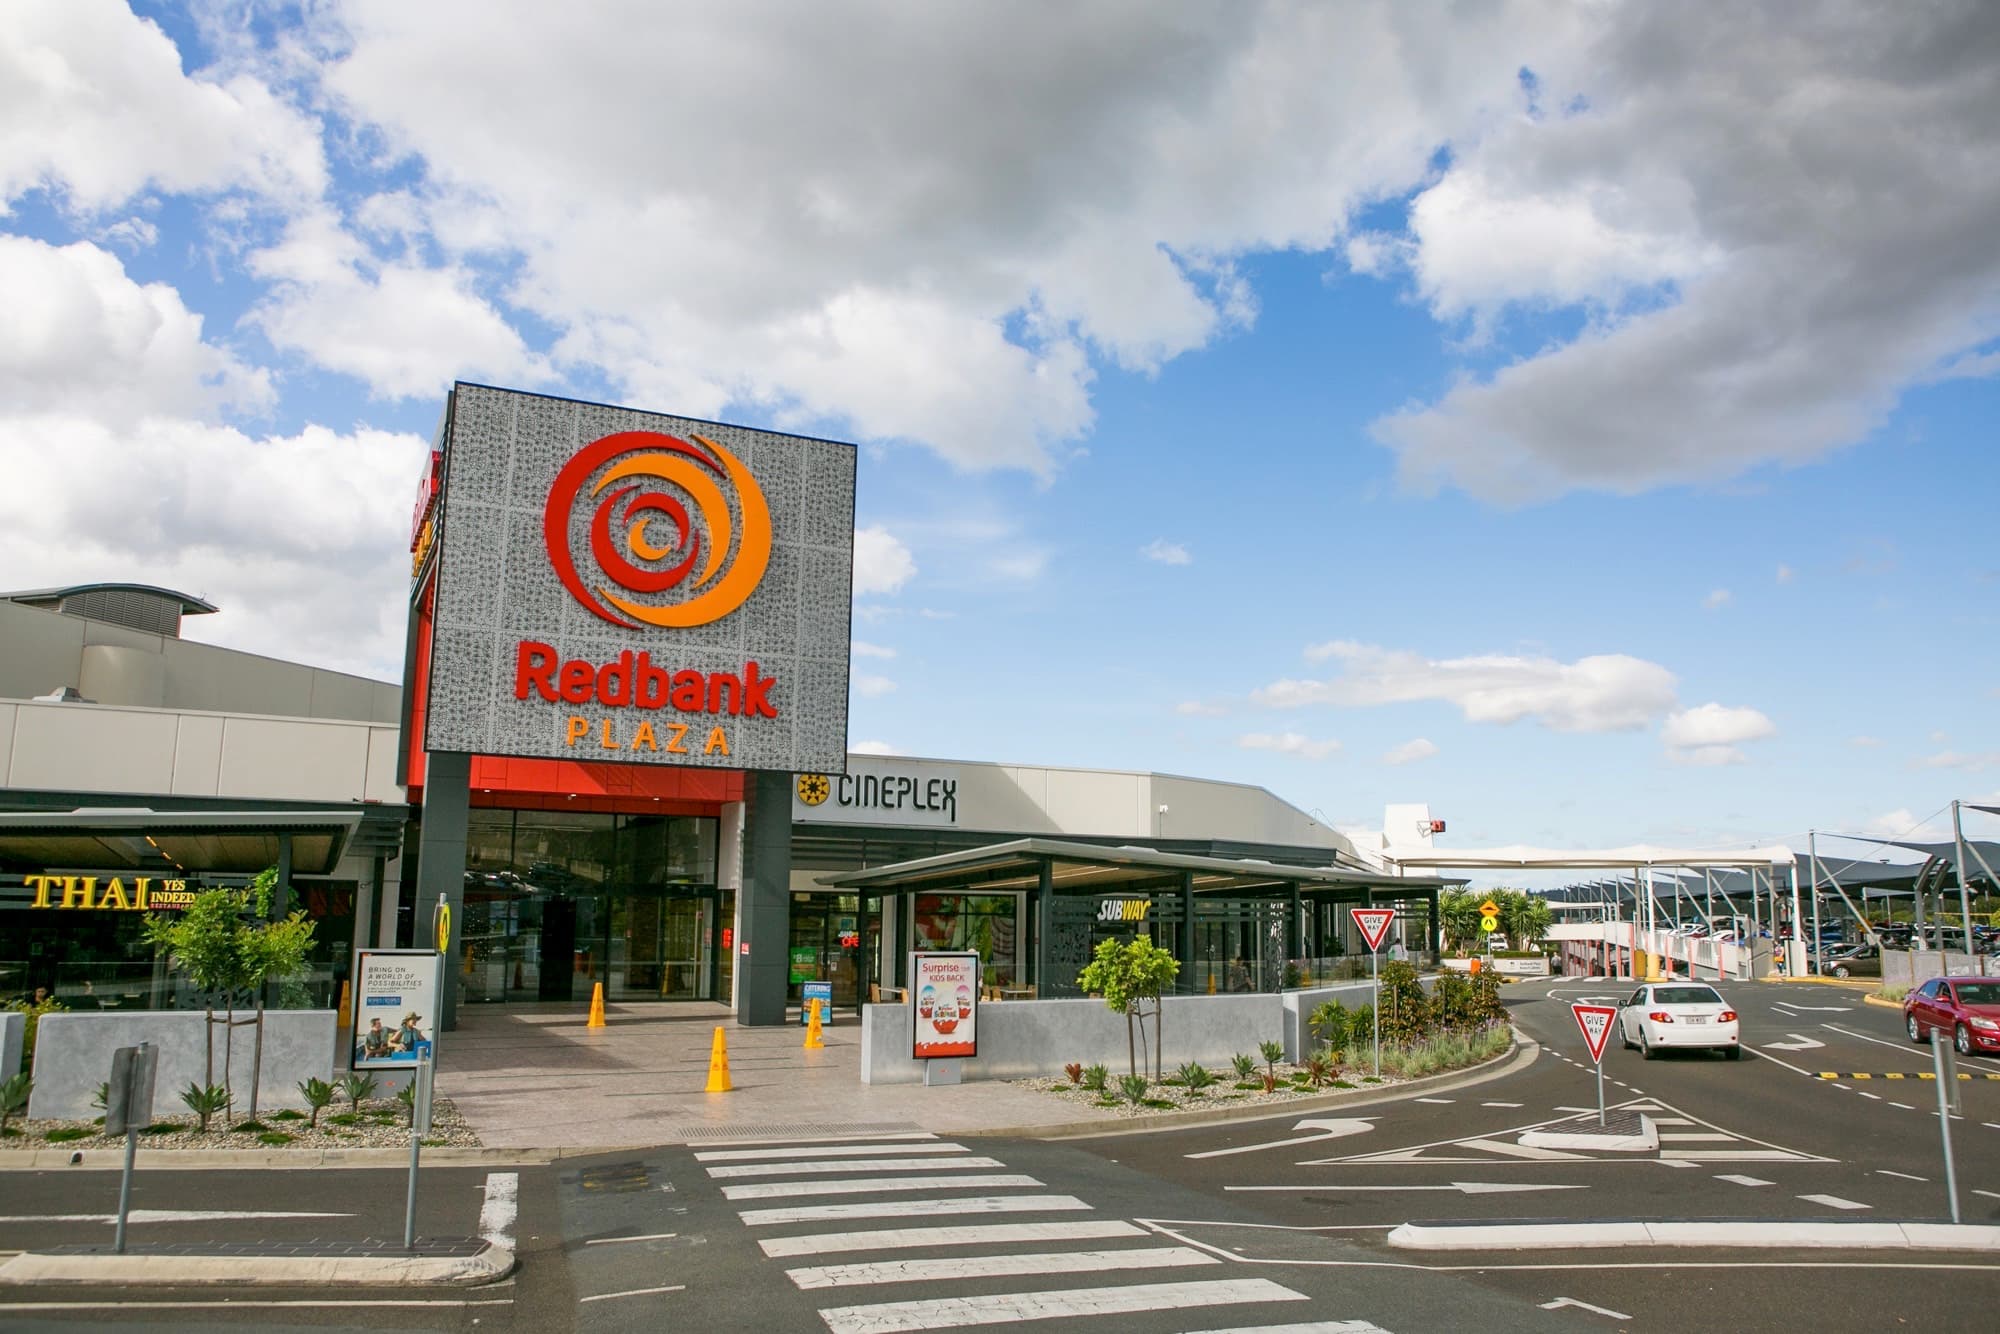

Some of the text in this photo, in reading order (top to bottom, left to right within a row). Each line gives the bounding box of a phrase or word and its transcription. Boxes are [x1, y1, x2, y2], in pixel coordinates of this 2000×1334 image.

[514, 640, 778, 719] Redbank
[566, 715, 730, 756] PLAZA
[837, 774, 957, 823] CINEPLEX
[23, 874, 152, 911] THAI
[162, 878, 186, 891] YES
[150, 891, 196, 903] INDEED
[1097, 899, 1152, 921] SUBWAY
[922, 963, 960, 974] Surprise
[1586, 1015, 1605, 1026] GIVE
